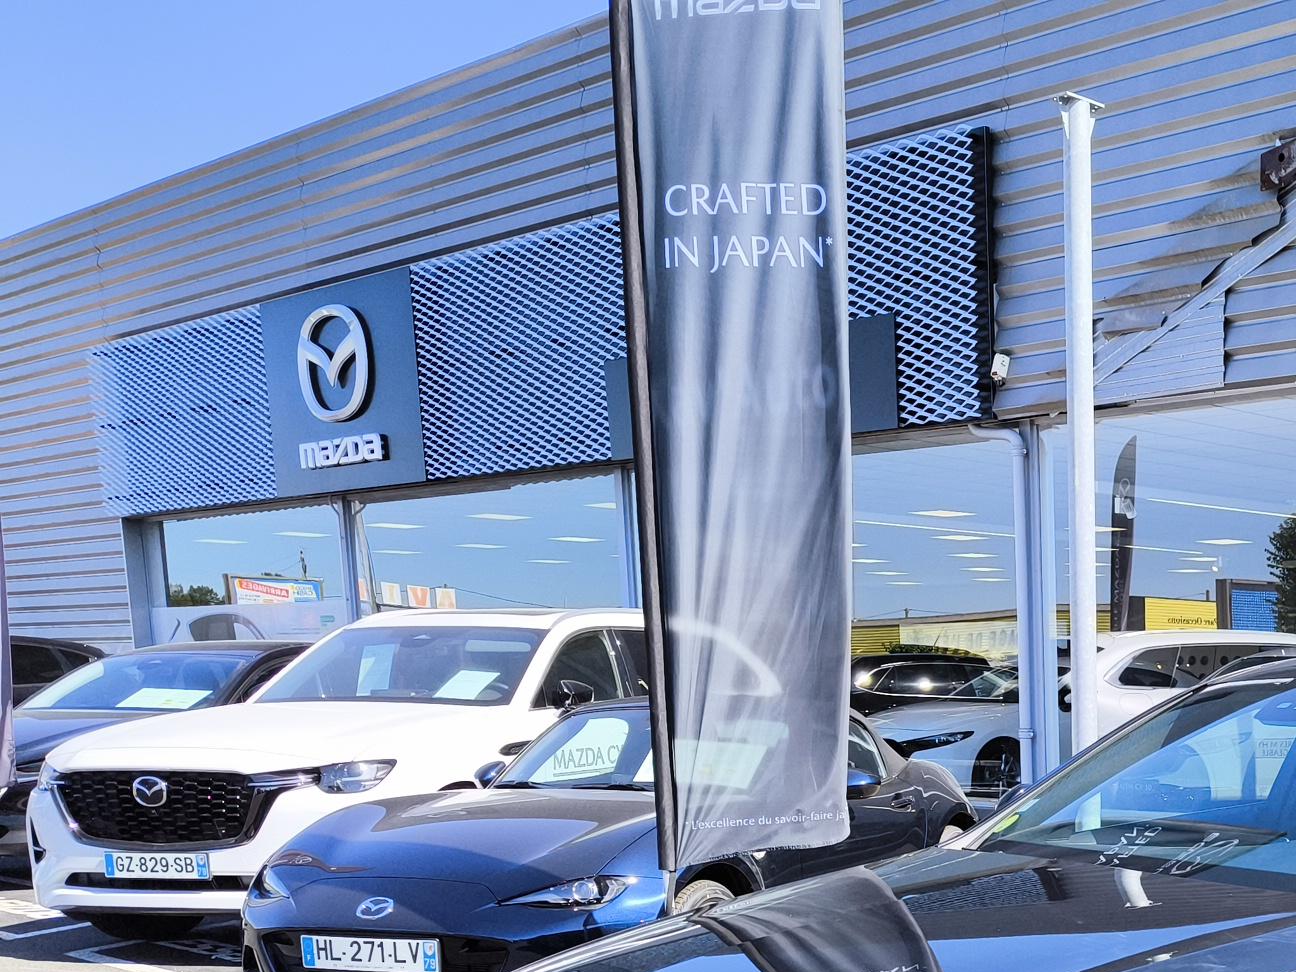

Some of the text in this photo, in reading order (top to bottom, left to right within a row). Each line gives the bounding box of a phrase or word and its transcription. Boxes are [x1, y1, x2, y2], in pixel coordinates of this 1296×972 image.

[664, 182, 827, 217] CRAFTED
[664, 235, 700, 269] IN
[298, 432, 383, 470] mazda
[553, 747, 605, 770] MAZDA
[758, 814, 772, 825] du
[774, 810, 833, 824] savoir-faire
[115, 855, 194, 873] GZ-829-SB
[315, 938, 420, 964] HL-271-LV
[424, 958, 436, 969] 79
